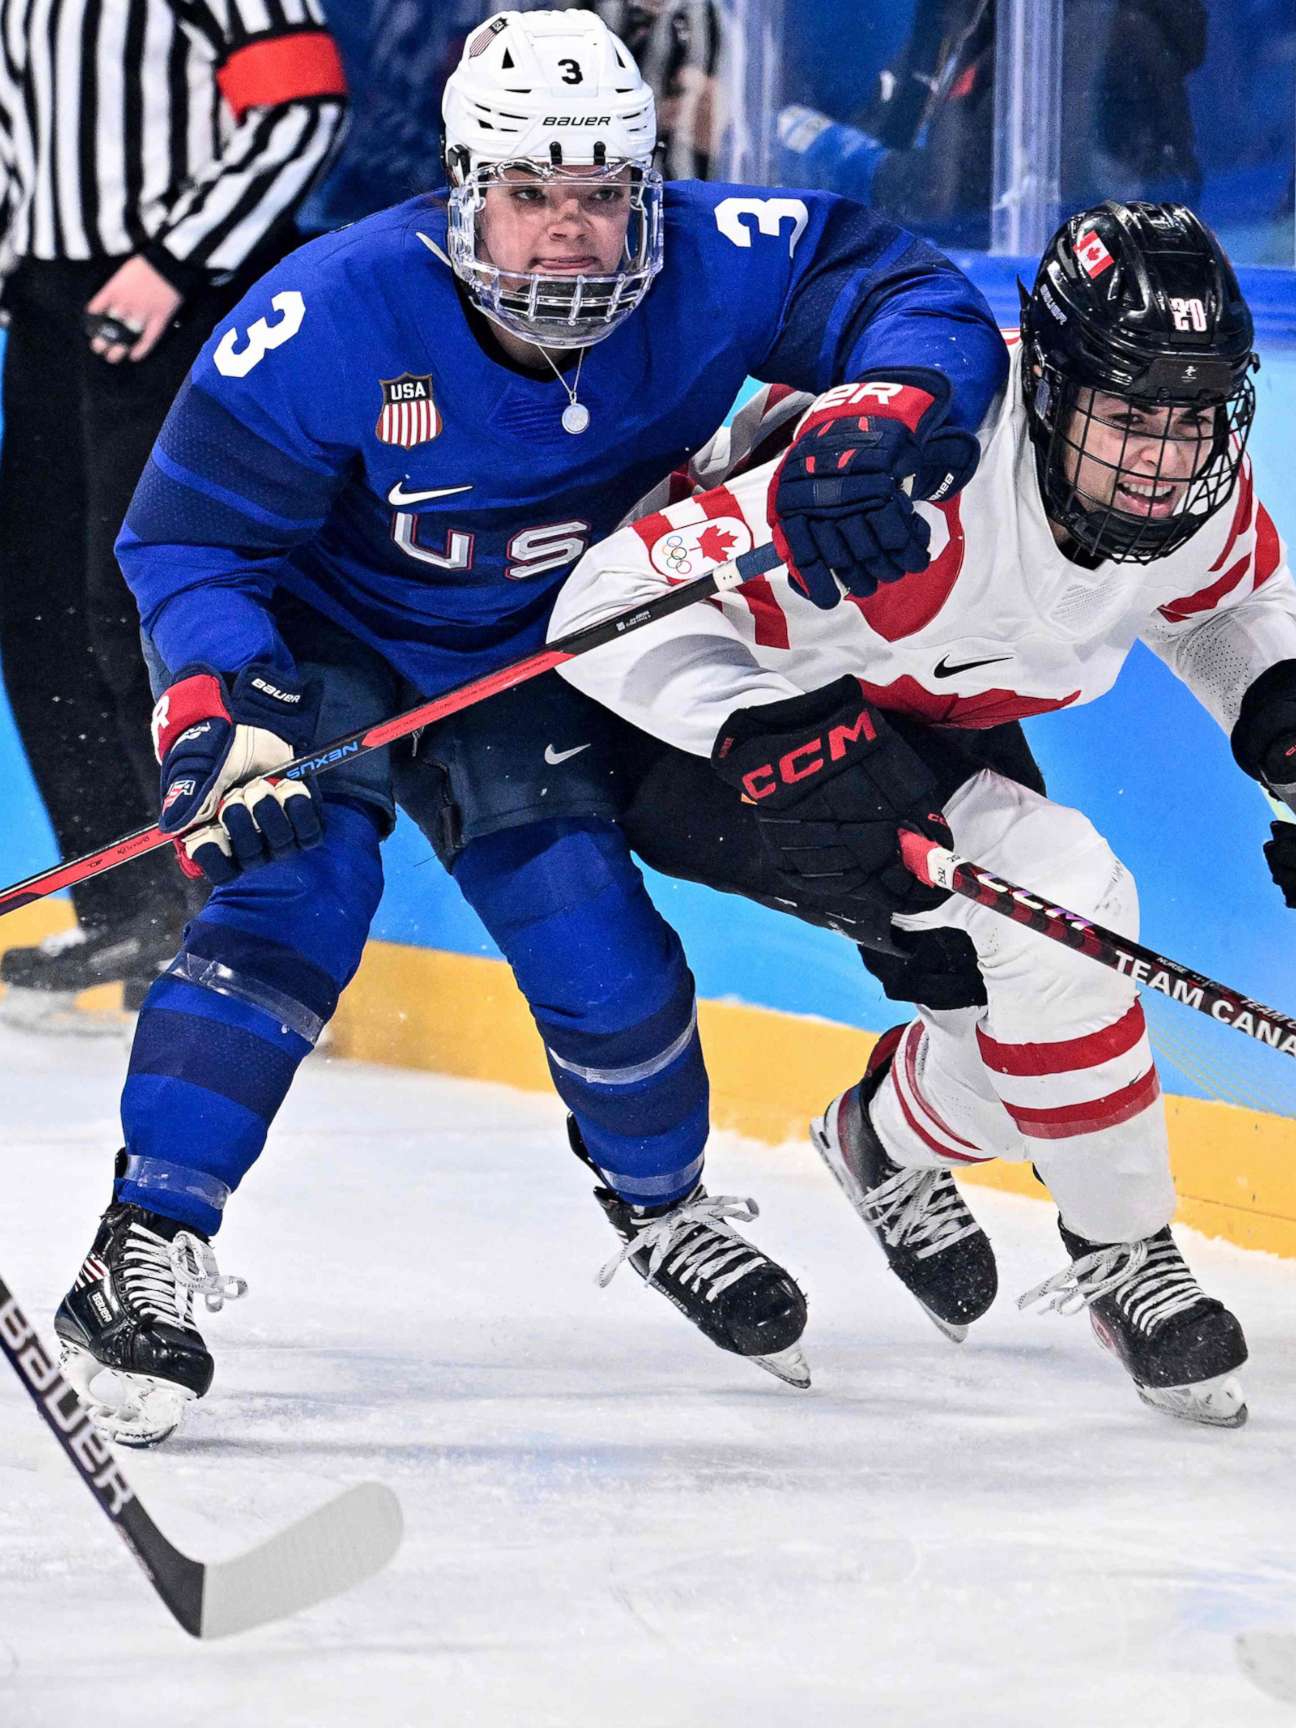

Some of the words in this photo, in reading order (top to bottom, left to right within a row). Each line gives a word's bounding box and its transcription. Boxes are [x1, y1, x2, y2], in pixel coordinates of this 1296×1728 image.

[557, 58, 584, 85] 3
[542, 115, 612, 127] BAUER
[713, 197, 809, 260] 3
[1168, 298, 1207, 332] 20
[213, 291, 306, 378] 3
[390, 381, 427, 401] USA
[251, 677, 301, 704] BAUER
[286, 740, 359, 780] NEXUS
[741, 707, 878, 800] CCM
[1115, 949, 1205, 1010] TEAM
[1240, 997, 1287, 1023] TEAM
